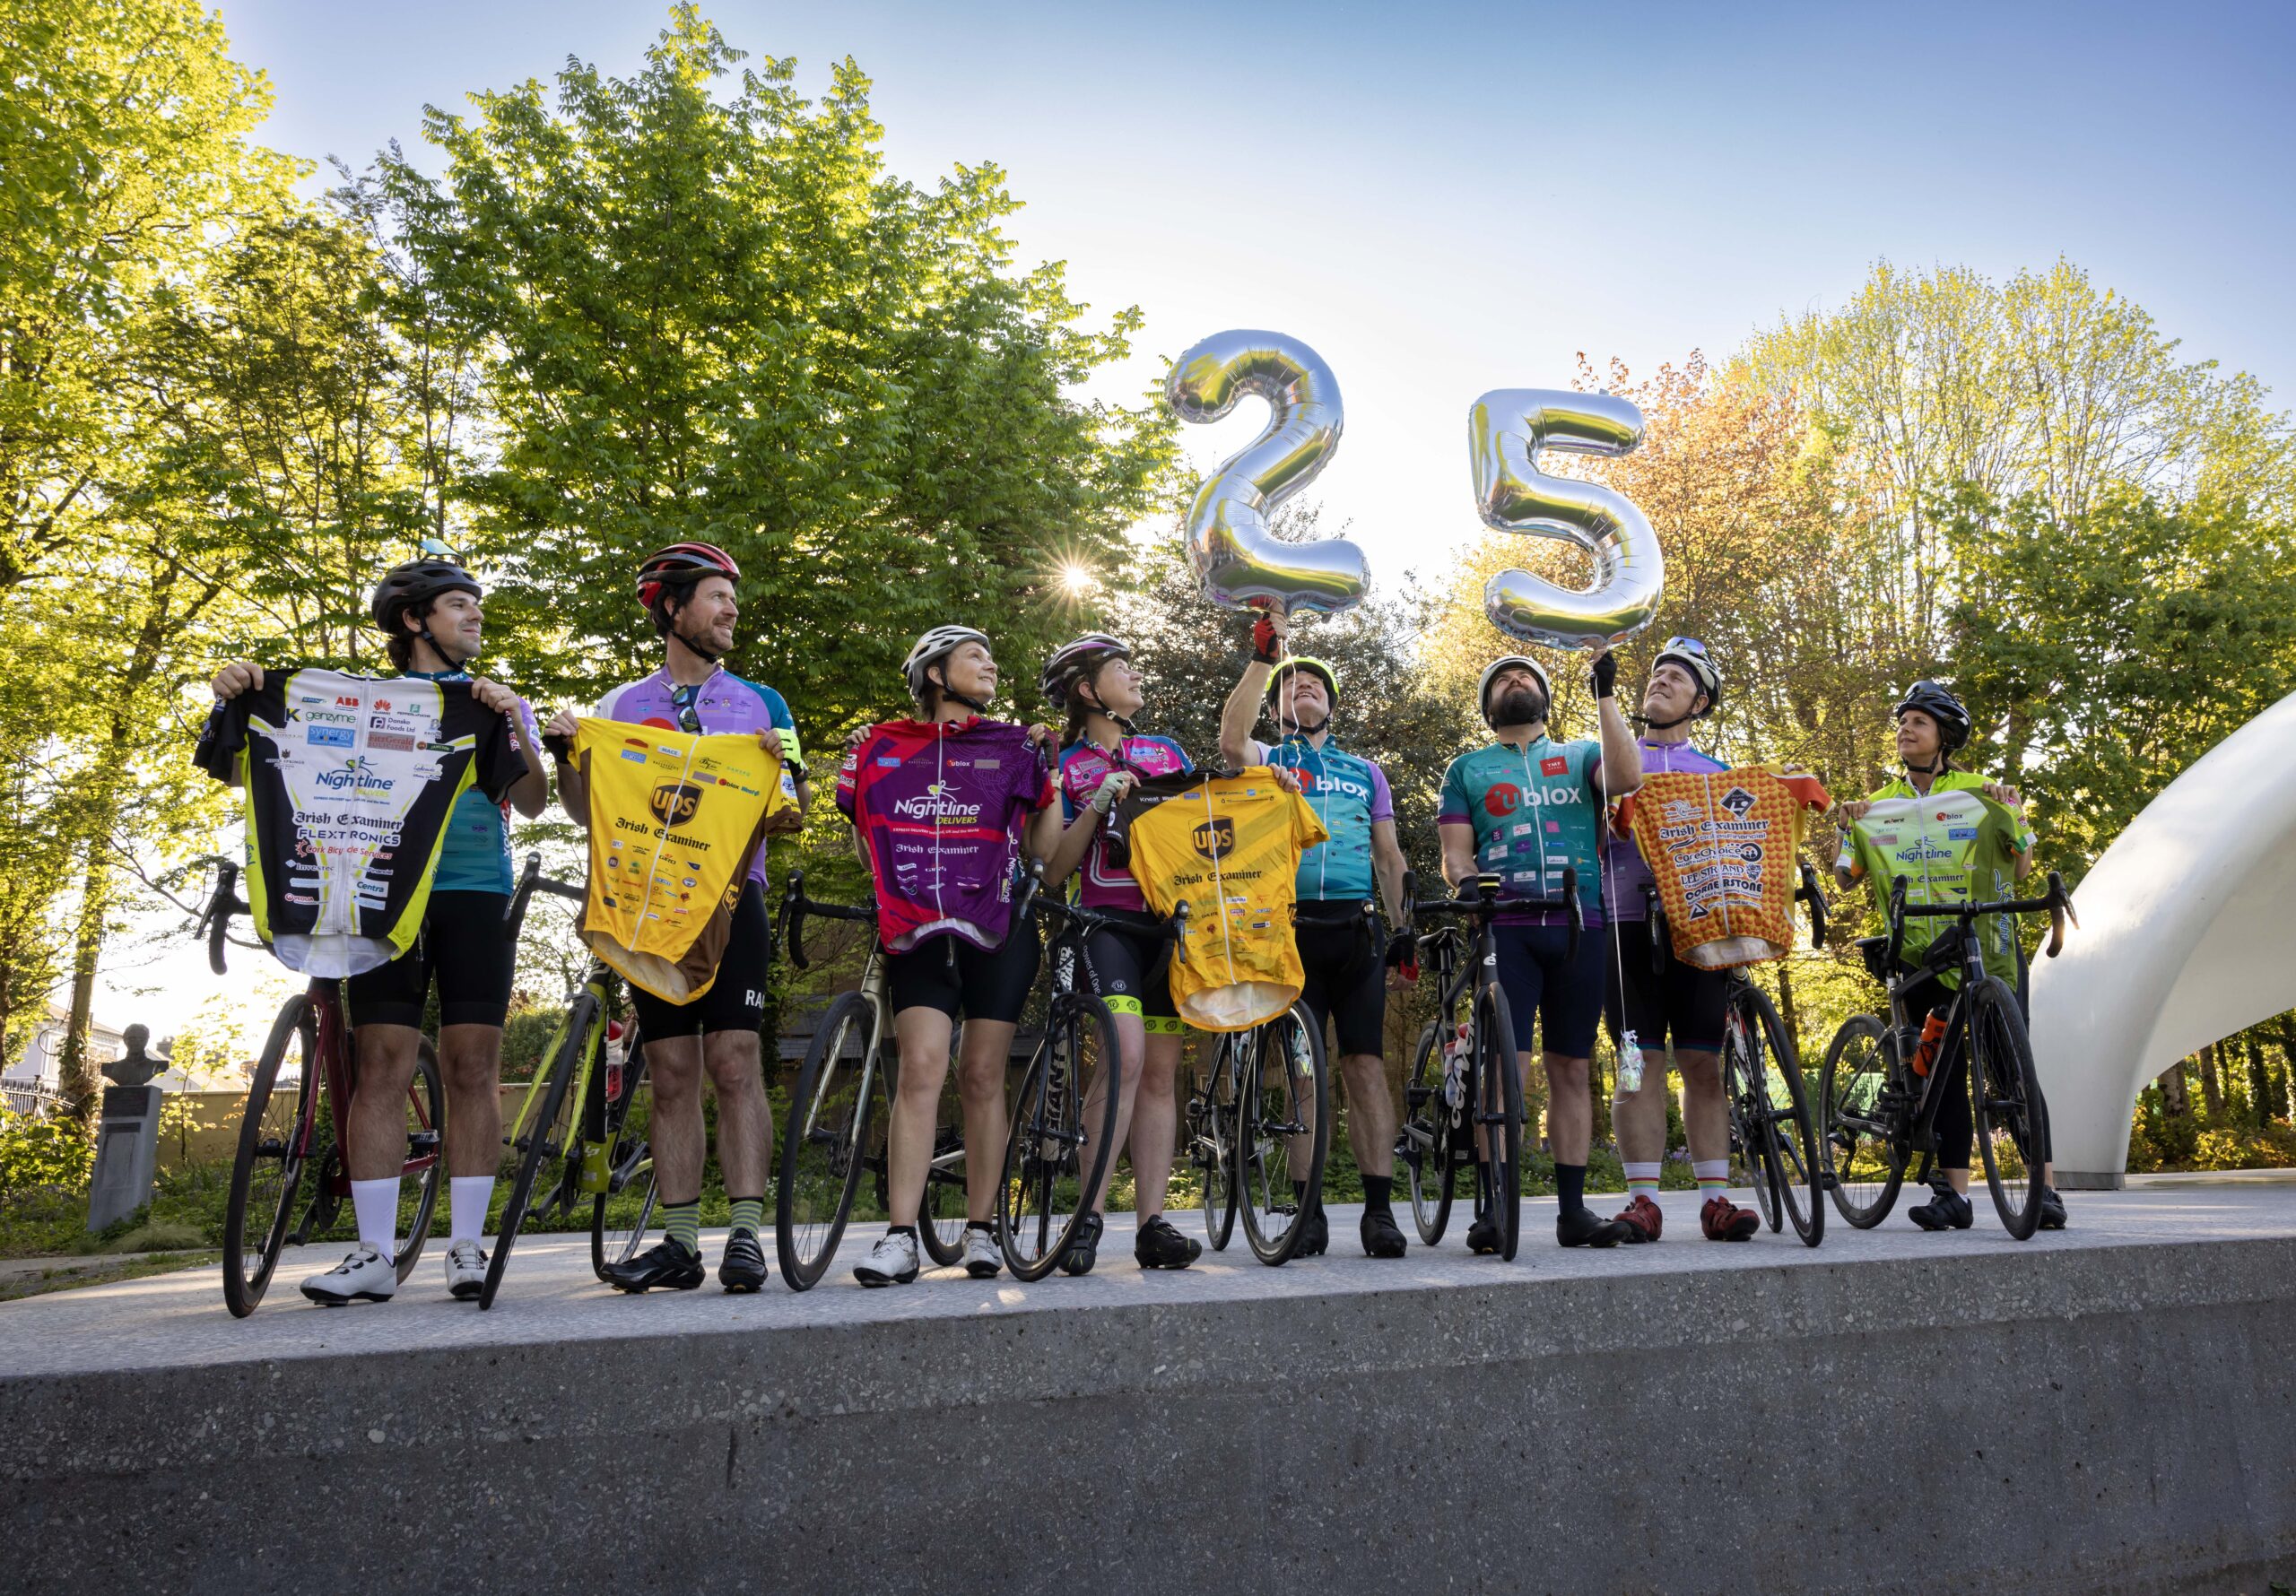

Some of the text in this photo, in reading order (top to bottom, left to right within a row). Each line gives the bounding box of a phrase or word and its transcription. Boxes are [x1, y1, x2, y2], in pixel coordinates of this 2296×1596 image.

[1166, 329, 1665, 652] 2 5
[335, 696, 359, 707] ABB
[285, 708, 301, 723] K
[306, 711, 357, 724] genzyme
[387, 717, 411, 725] Dansko
[309, 727, 353, 742] synergy
[369, 733, 415, 746] FitzGerald
[661, 747, 678, 756] MACE
[316, 771, 395, 790] Nightline
[653, 789, 696, 820] ups
[893, 800, 981, 820] Nightline
[295, 811, 403, 830] Irish Examiner
[935, 816, 978, 825] DELIVERS
[300, 828, 399, 845] FLEXTRONICS
[615, 817, 649, 835] Irish
[653, 828, 711, 852] Examiner
[1660, 820, 1769, 839] Irish Examiner
[895, 844, 979, 855] Irish Examiner
[1194, 828, 1232, 855] ups
[305, 845, 325, 854] Cork
[361, 848, 393, 861] Services
[1896, 849, 1952, 863] Nightline
[296, 863, 335, 872] Investec
[1681, 873, 1699, 885] LEE
[1700, 864, 1744, 879] STRAND
[1173, 870, 1262, 886] Irish Examiner
[1918, 873, 1964, 884] Examiner
[357, 880, 385, 893] Centra
[1686, 879, 1761, 900] CORNERSTONE
[1091, 976, 1101, 995] One
[745, 990, 765, 1010] RA
